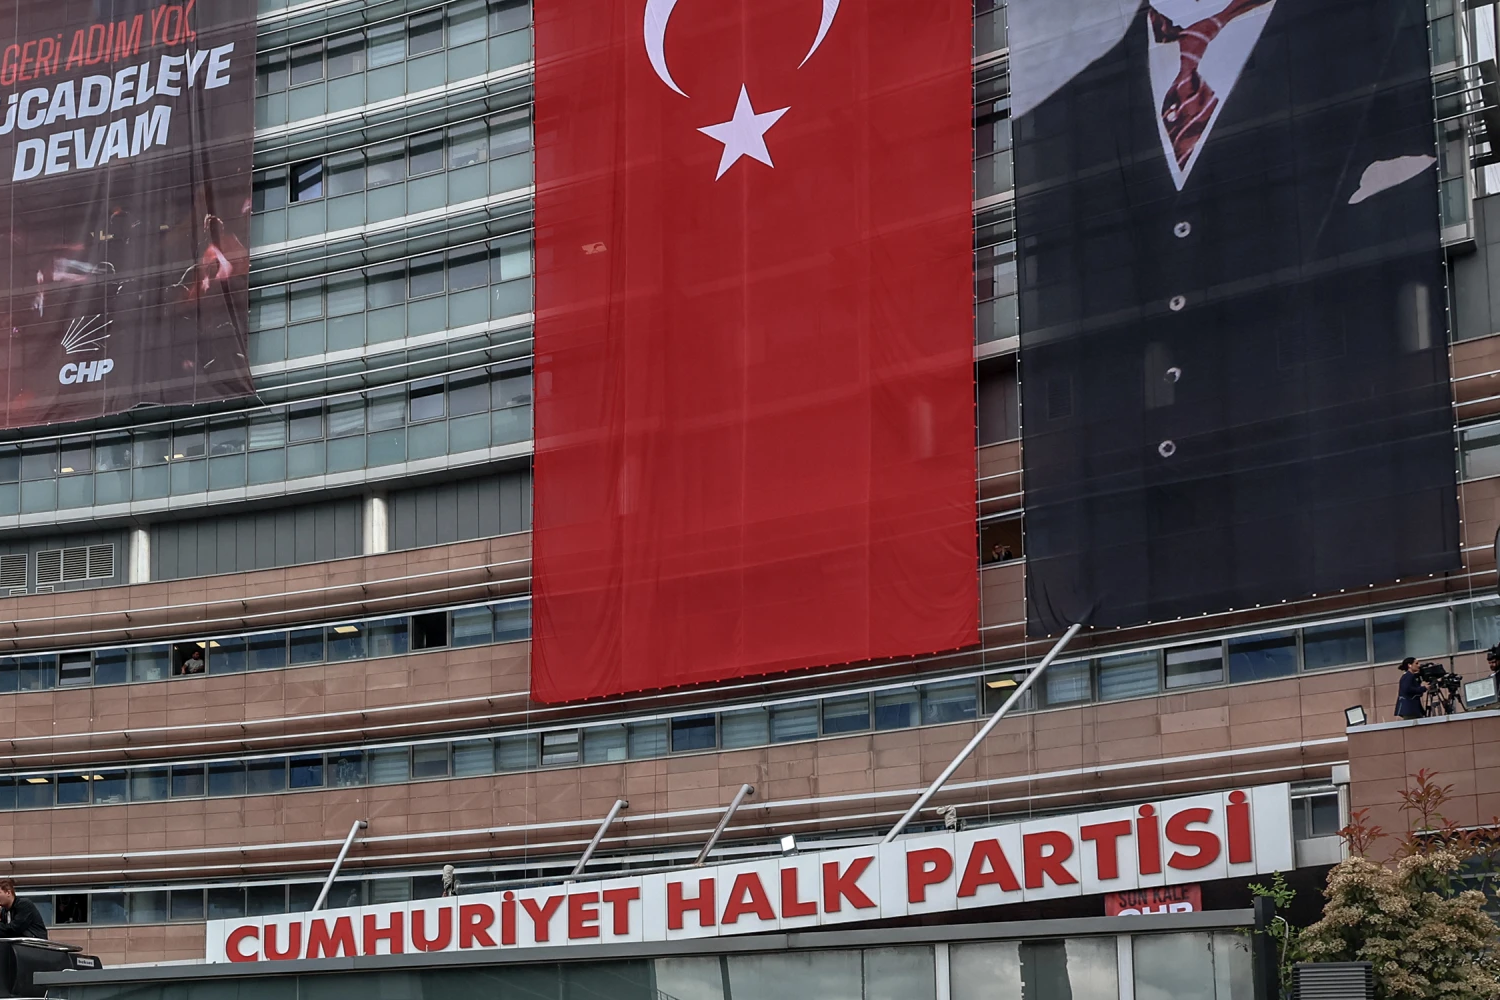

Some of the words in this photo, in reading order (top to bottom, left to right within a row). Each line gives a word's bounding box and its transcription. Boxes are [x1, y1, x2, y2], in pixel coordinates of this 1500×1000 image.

[0, 33, 61, 86] GERİ
[65, 14, 143, 72] ADIM
[12, 105, 172, 181] DEVAM
[58, 358, 114, 385] CHP
[226, 887, 641, 964] CUMHURİYET
[666, 855, 877, 931] HALK
[906, 789, 1253, 904] PARTİSİ
[1152, 884, 1191, 904] KALE
